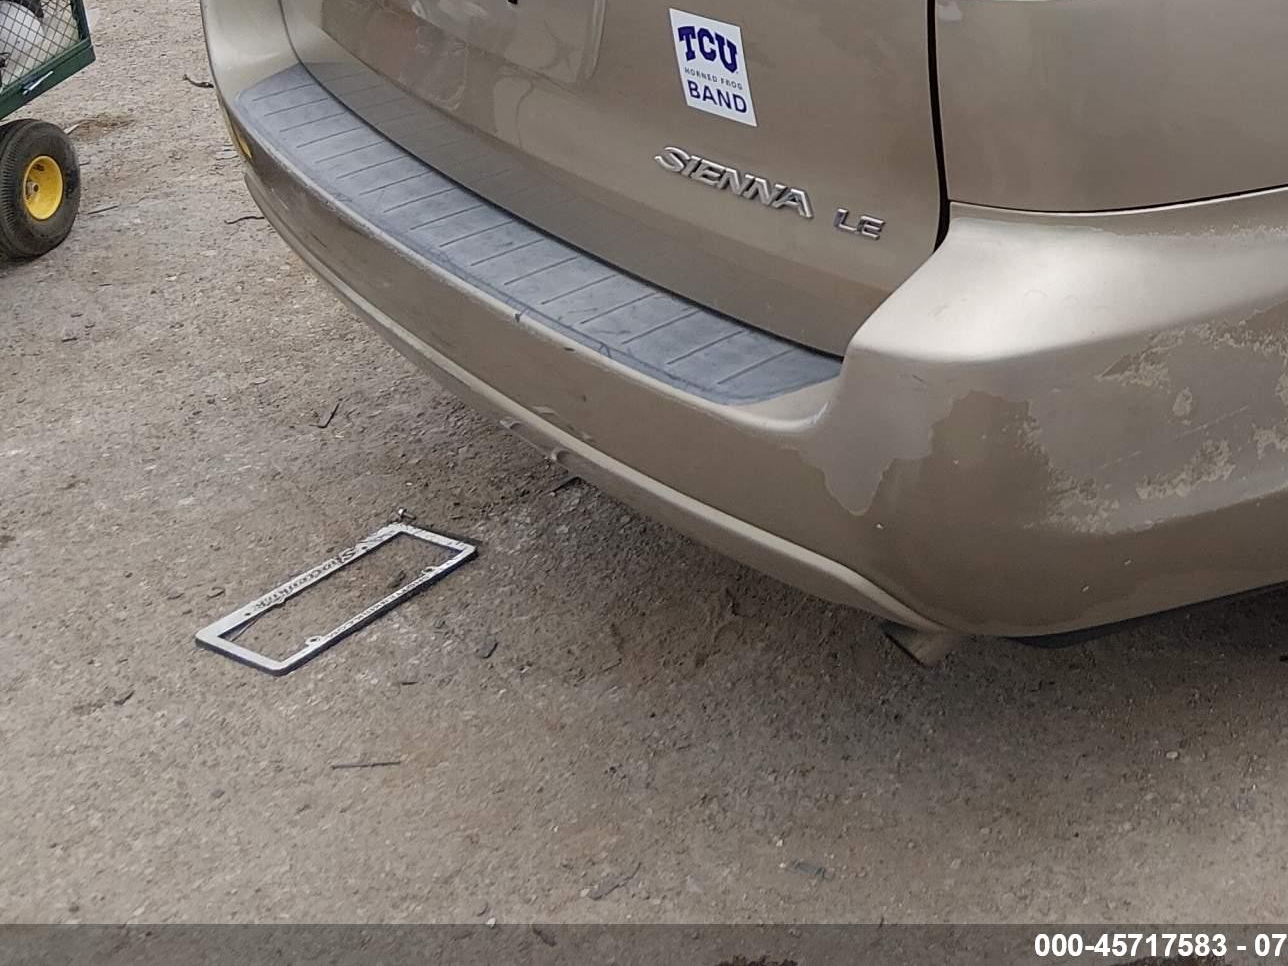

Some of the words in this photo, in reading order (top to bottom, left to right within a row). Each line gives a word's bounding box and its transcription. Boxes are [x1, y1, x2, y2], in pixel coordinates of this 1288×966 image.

[677, 26, 738, 73] TCU
[684, 67, 718, 83] HORNED
[720, 77, 744, 91] FROG
[687, 79, 747, 114] BAND
[654, 146, 814, 218] SIENNA
[832, 207, 886, 241] LE
